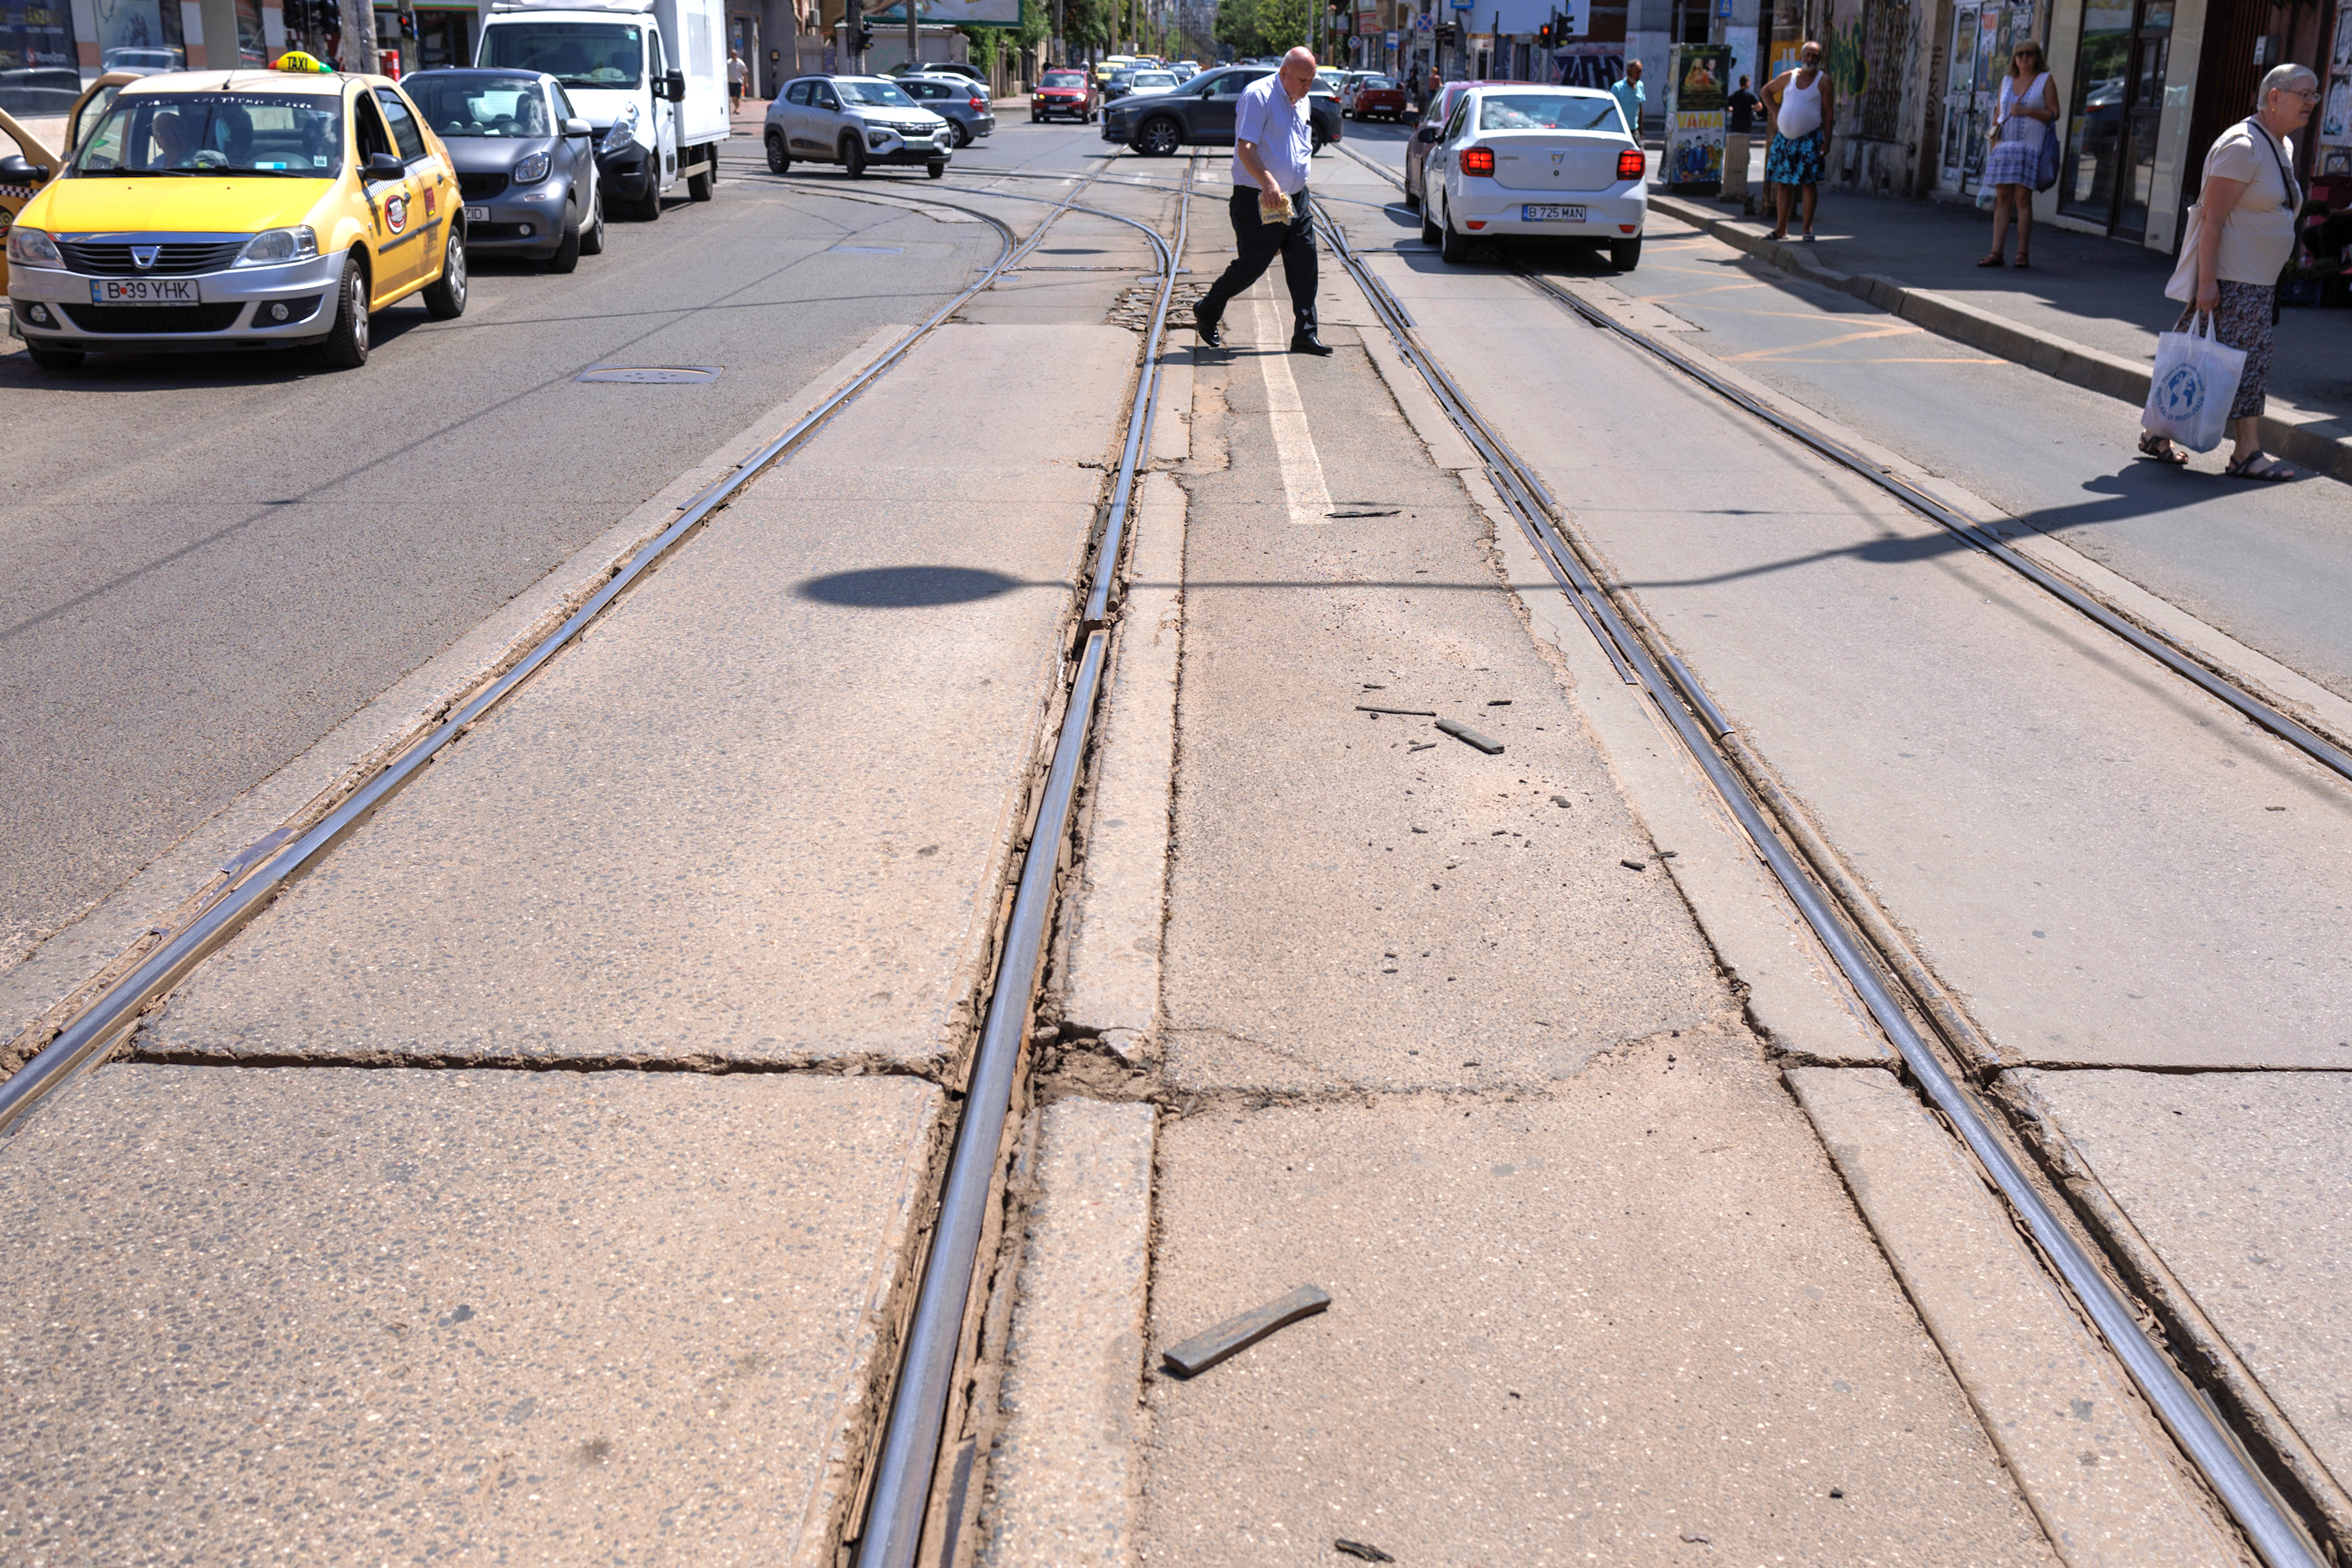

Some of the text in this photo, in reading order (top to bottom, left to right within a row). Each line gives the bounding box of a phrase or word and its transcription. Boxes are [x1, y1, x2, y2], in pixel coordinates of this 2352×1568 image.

[286, 55, 308, 71] TAXI
[1677, 112, 1724, 128] VAMA
[1529, 207, 1583, 218] B 725 MAN
[108, 282, 191, 298] B 39 YHK
